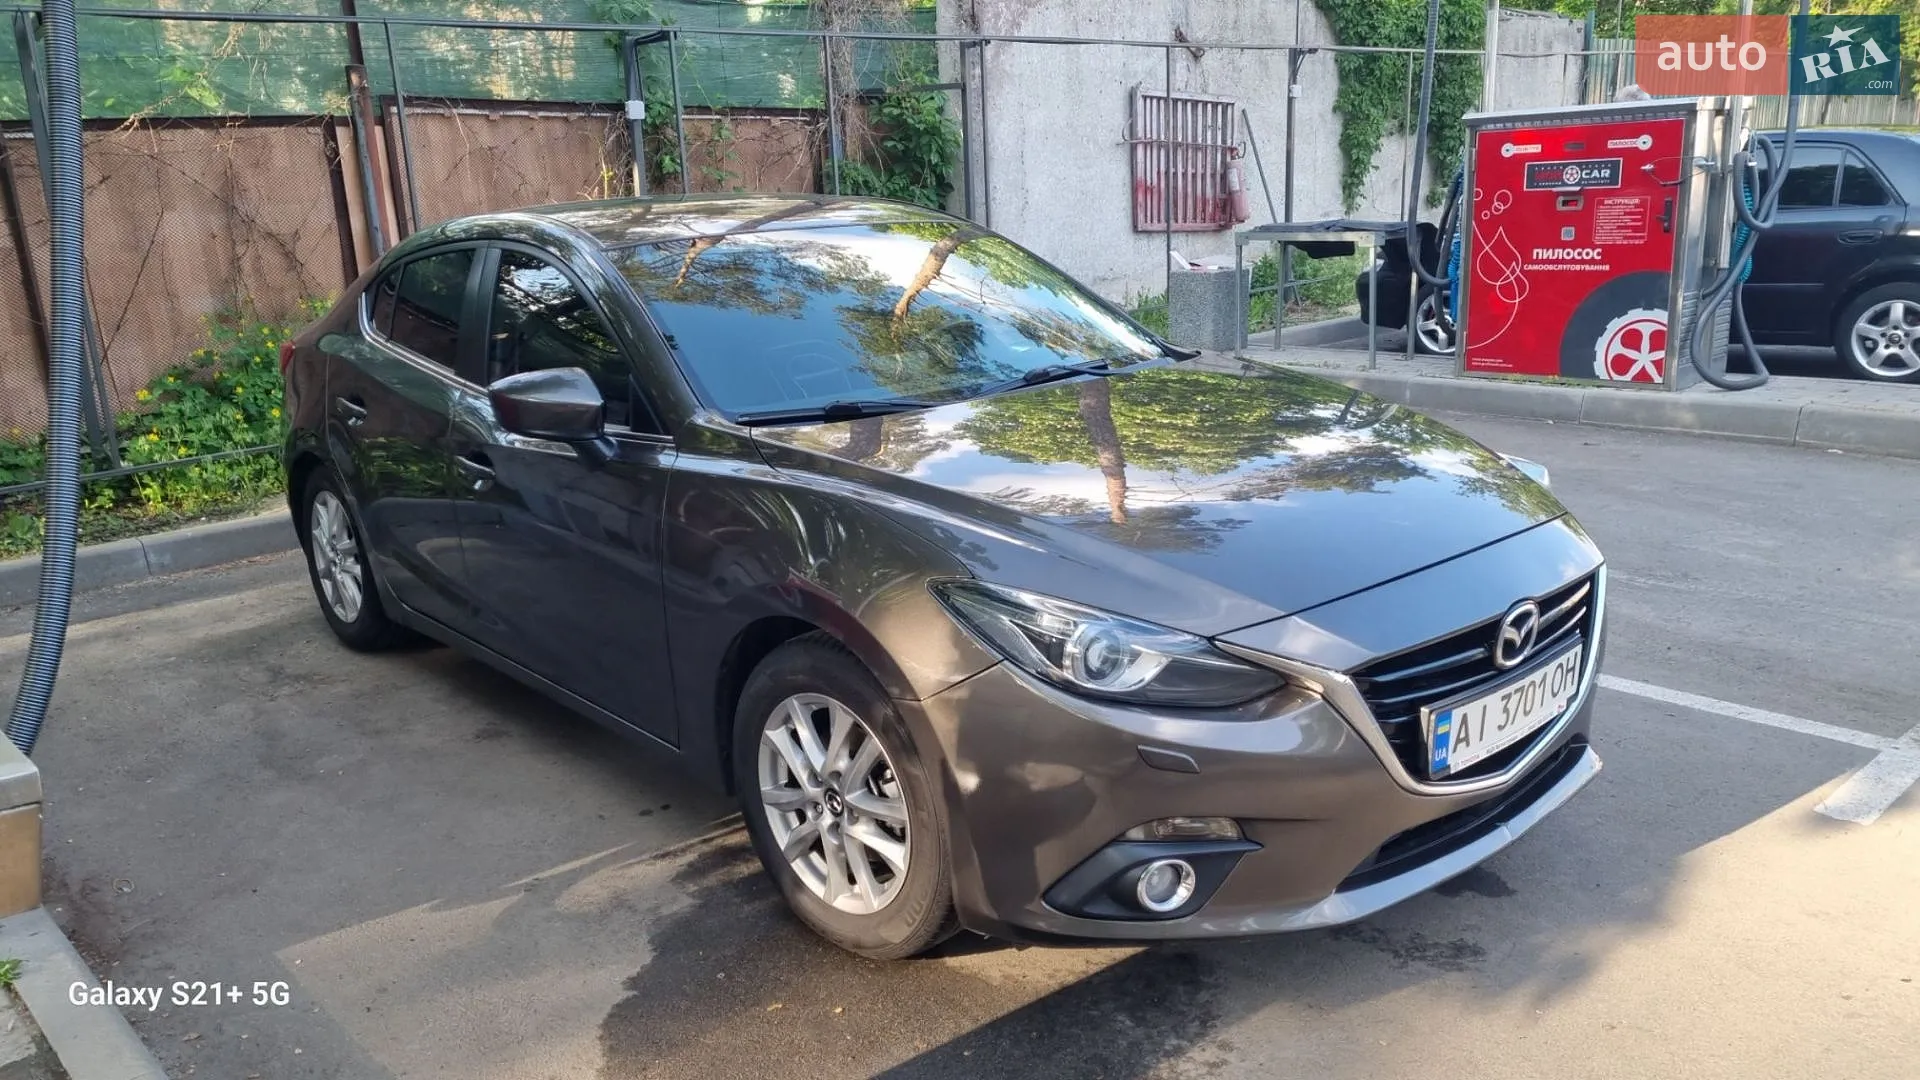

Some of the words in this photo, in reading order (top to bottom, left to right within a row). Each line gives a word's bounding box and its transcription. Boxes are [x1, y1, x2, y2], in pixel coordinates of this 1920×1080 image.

[1581, 169, 1611, 179] CAR
[1532, 248, 1602, 260] ПИЛОСОС
[1453, 704, 1487, 753] AI
[1497, 672, 1547, 731] 3701
[1551, 652, 1578, 698] OH
[1435, 748, 1448, 761] UA
